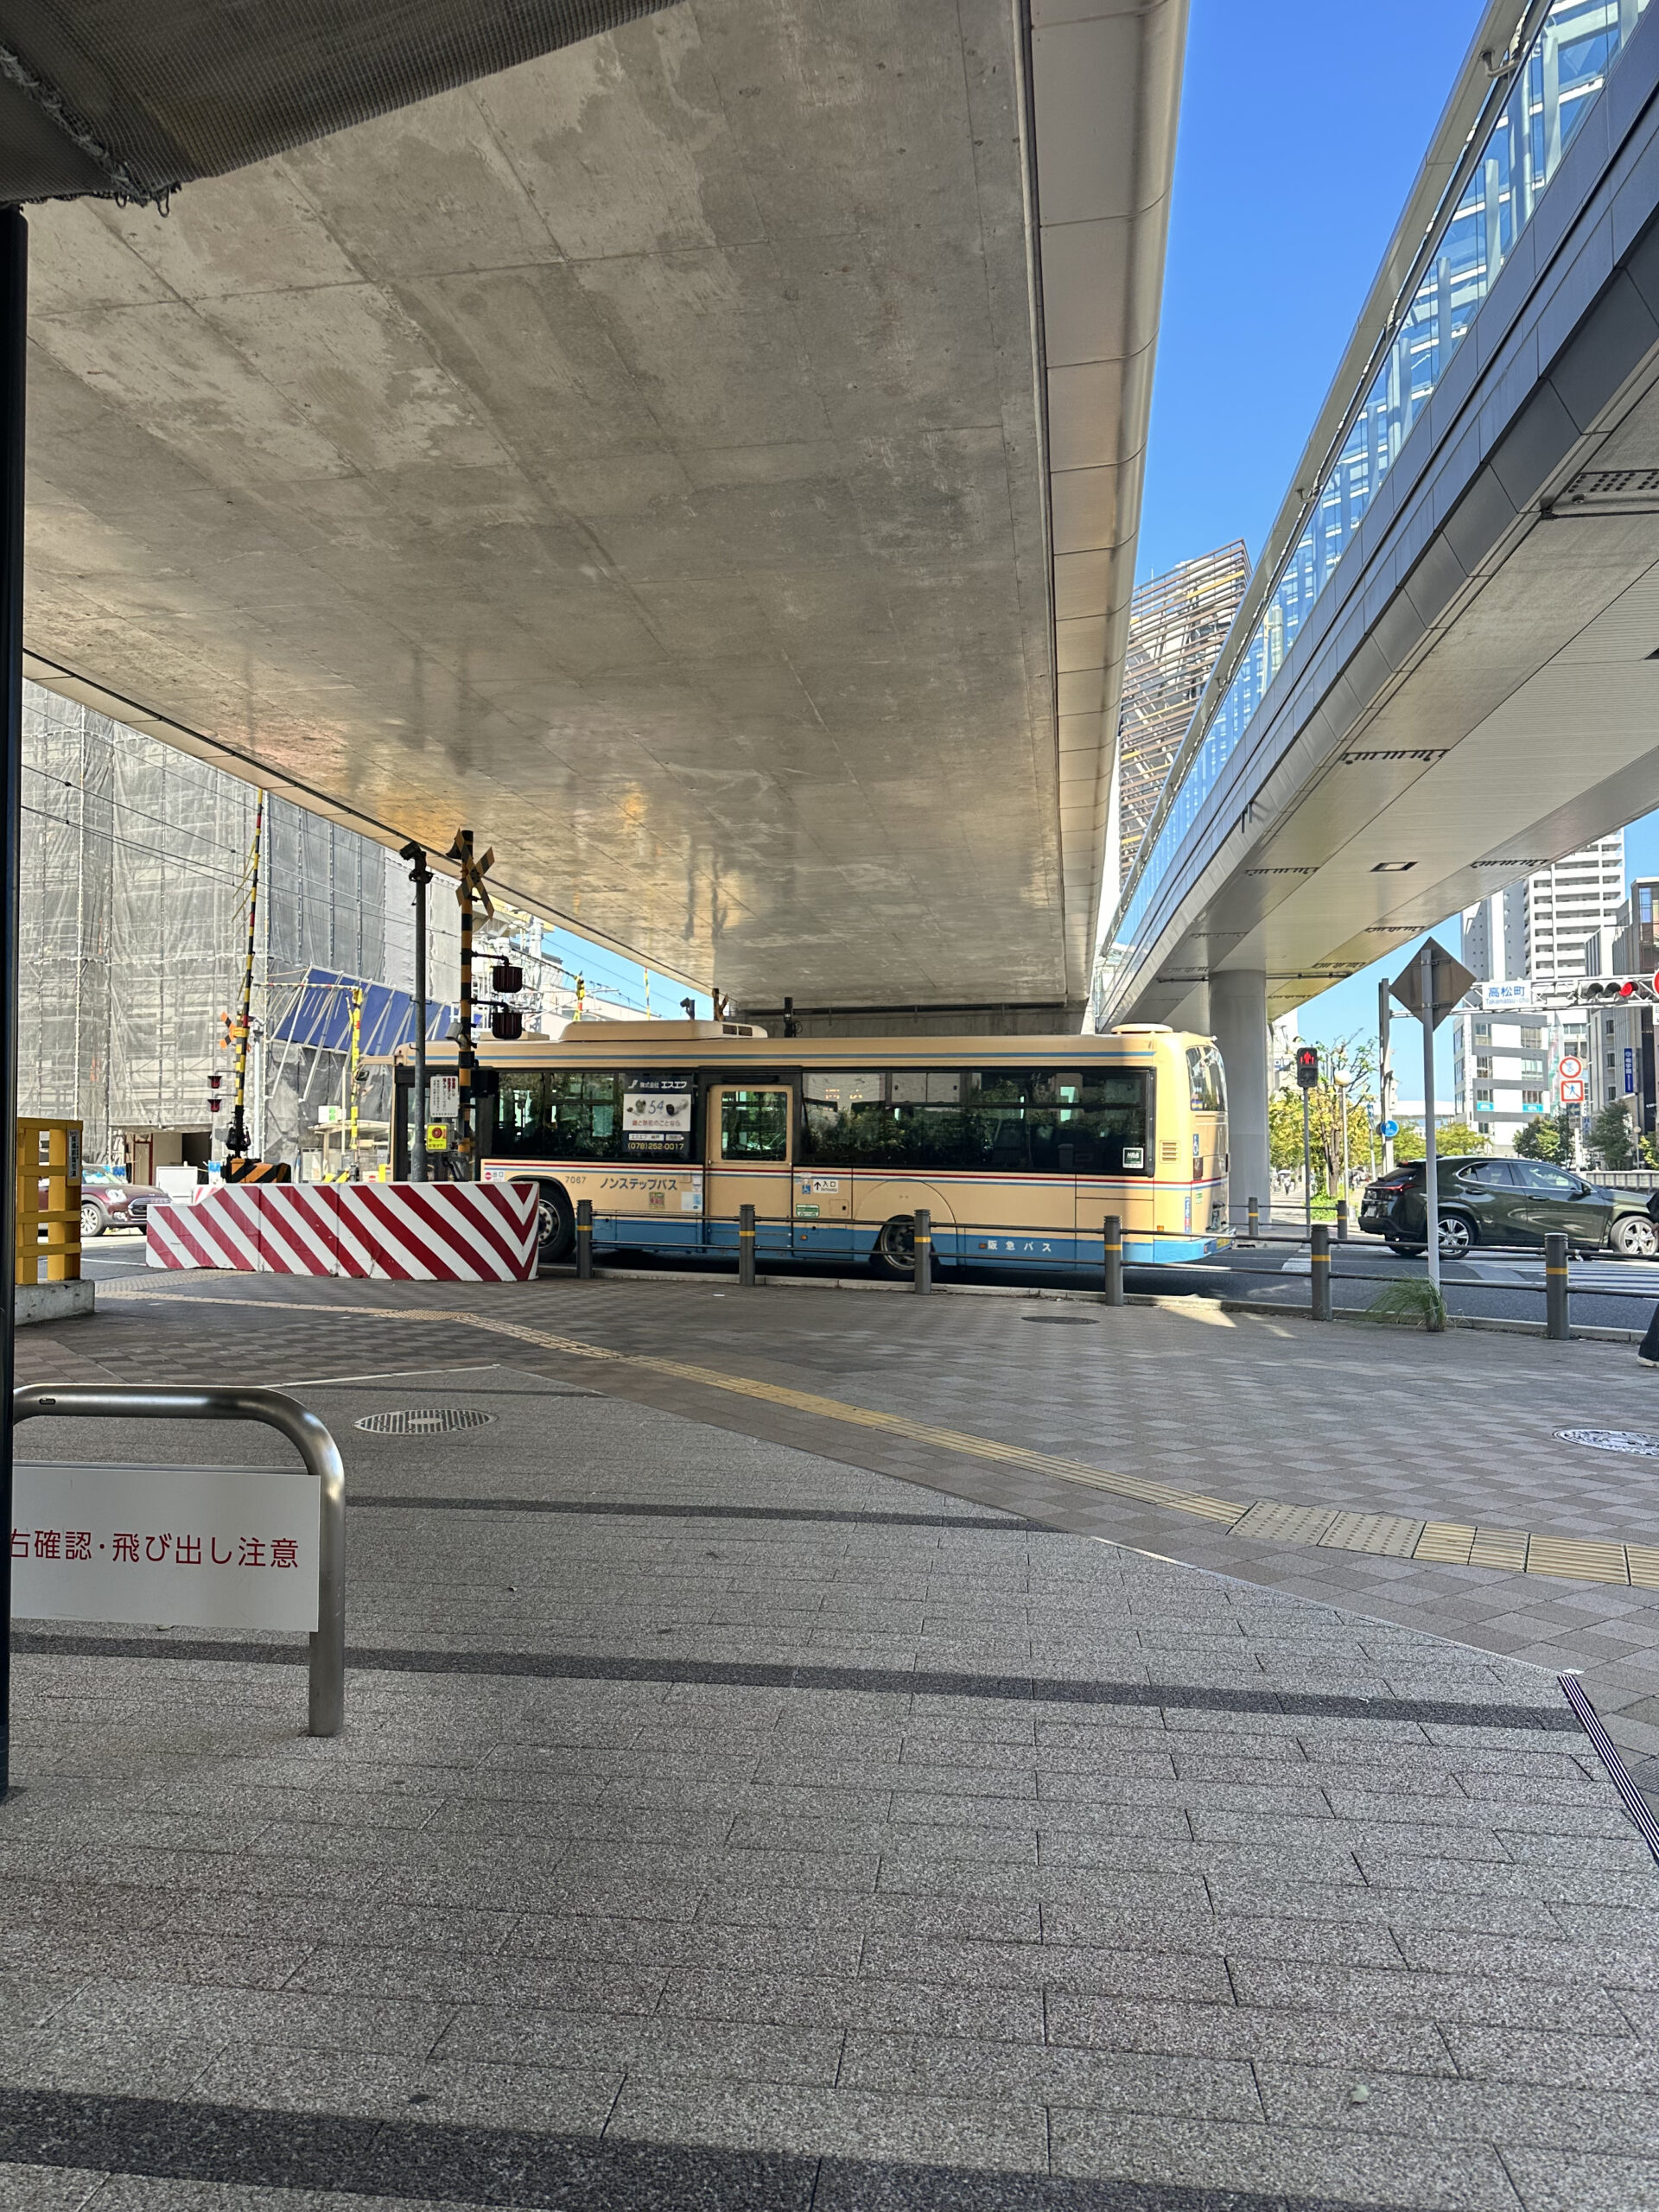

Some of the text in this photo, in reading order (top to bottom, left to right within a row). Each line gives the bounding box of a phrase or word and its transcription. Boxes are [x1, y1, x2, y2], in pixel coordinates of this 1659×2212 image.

[1488, 986, 1525, 998] 高松町
[600, 1178, 677, 1191] ノンステップバス
[988, 1240, 1051, 1252] 阪急バス
